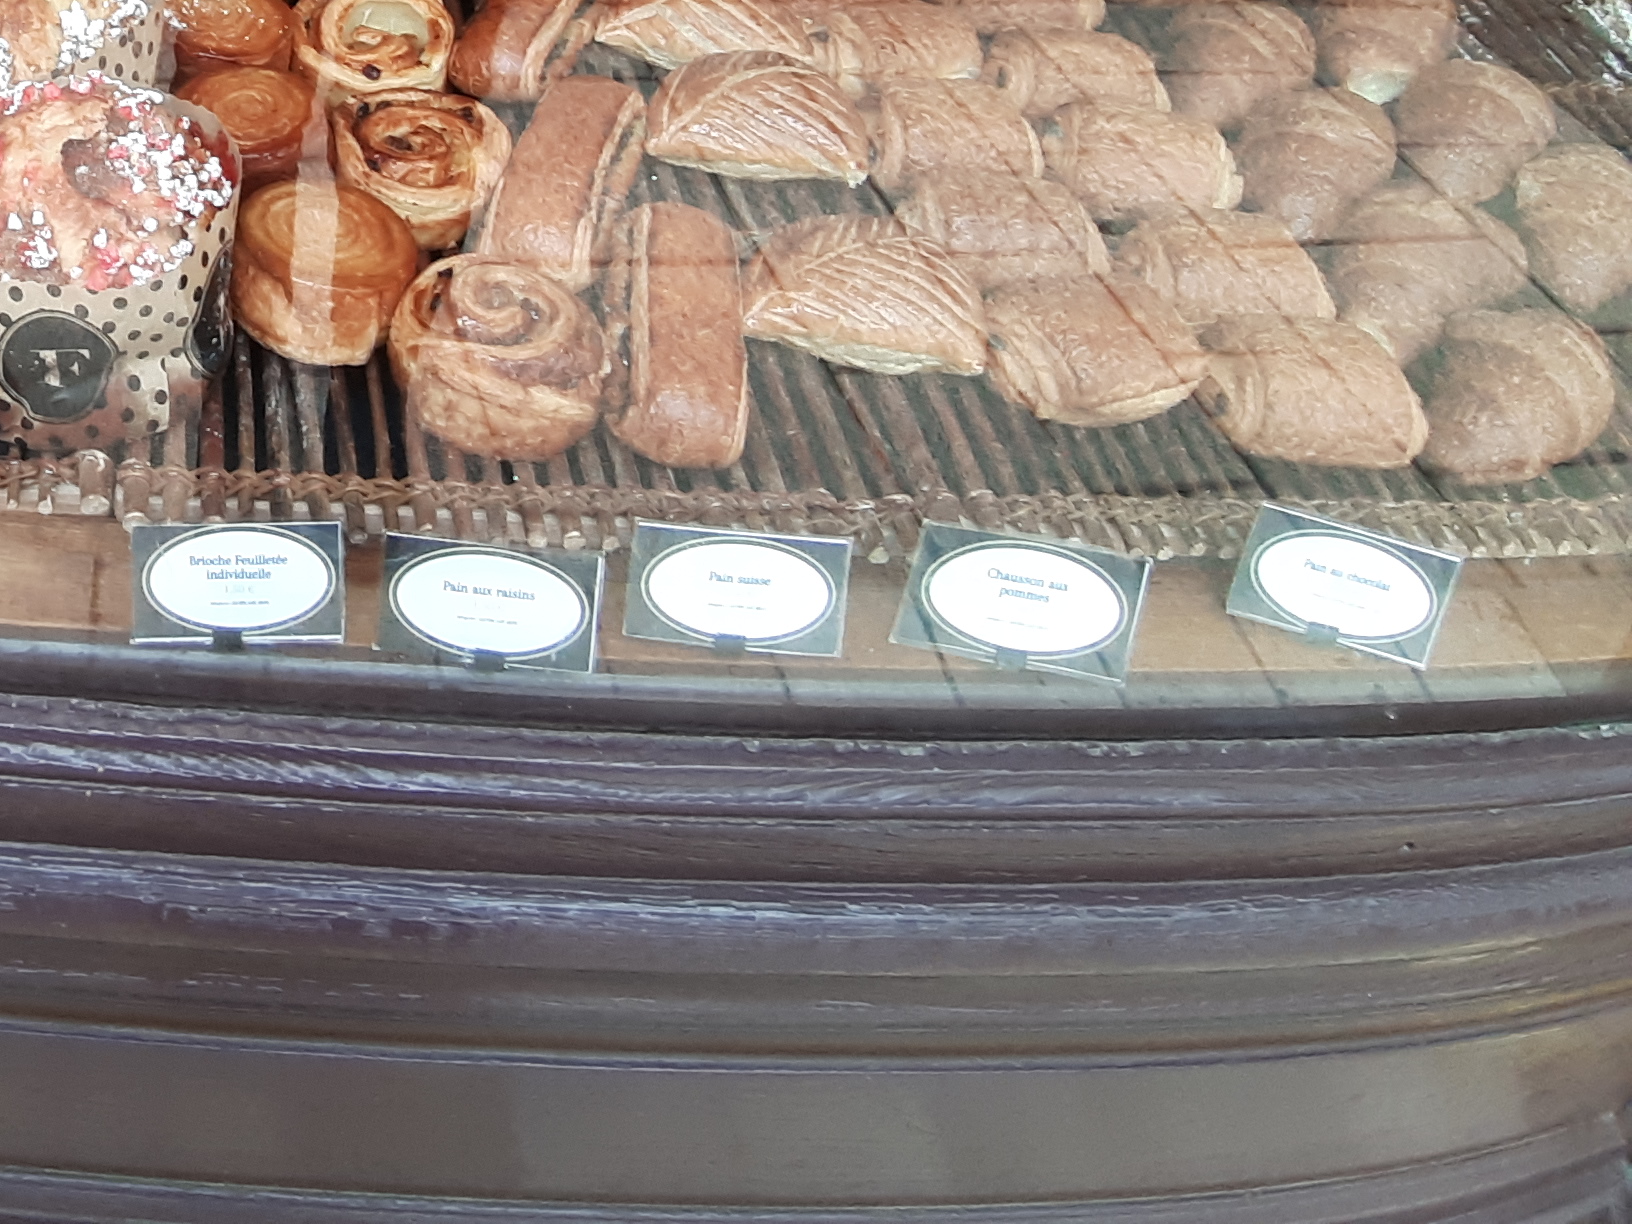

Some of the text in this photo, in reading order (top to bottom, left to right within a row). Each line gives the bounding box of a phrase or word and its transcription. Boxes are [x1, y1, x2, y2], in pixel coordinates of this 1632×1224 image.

[189, 554, 232, 566] Brioche
[709, 570, 772, 586] Pain suisse
[987, 567, 1069, 592] Chausson aux
[443, 579, 536, 601] Pain aux raisins
[998, 587, 1050, 603] pommes
